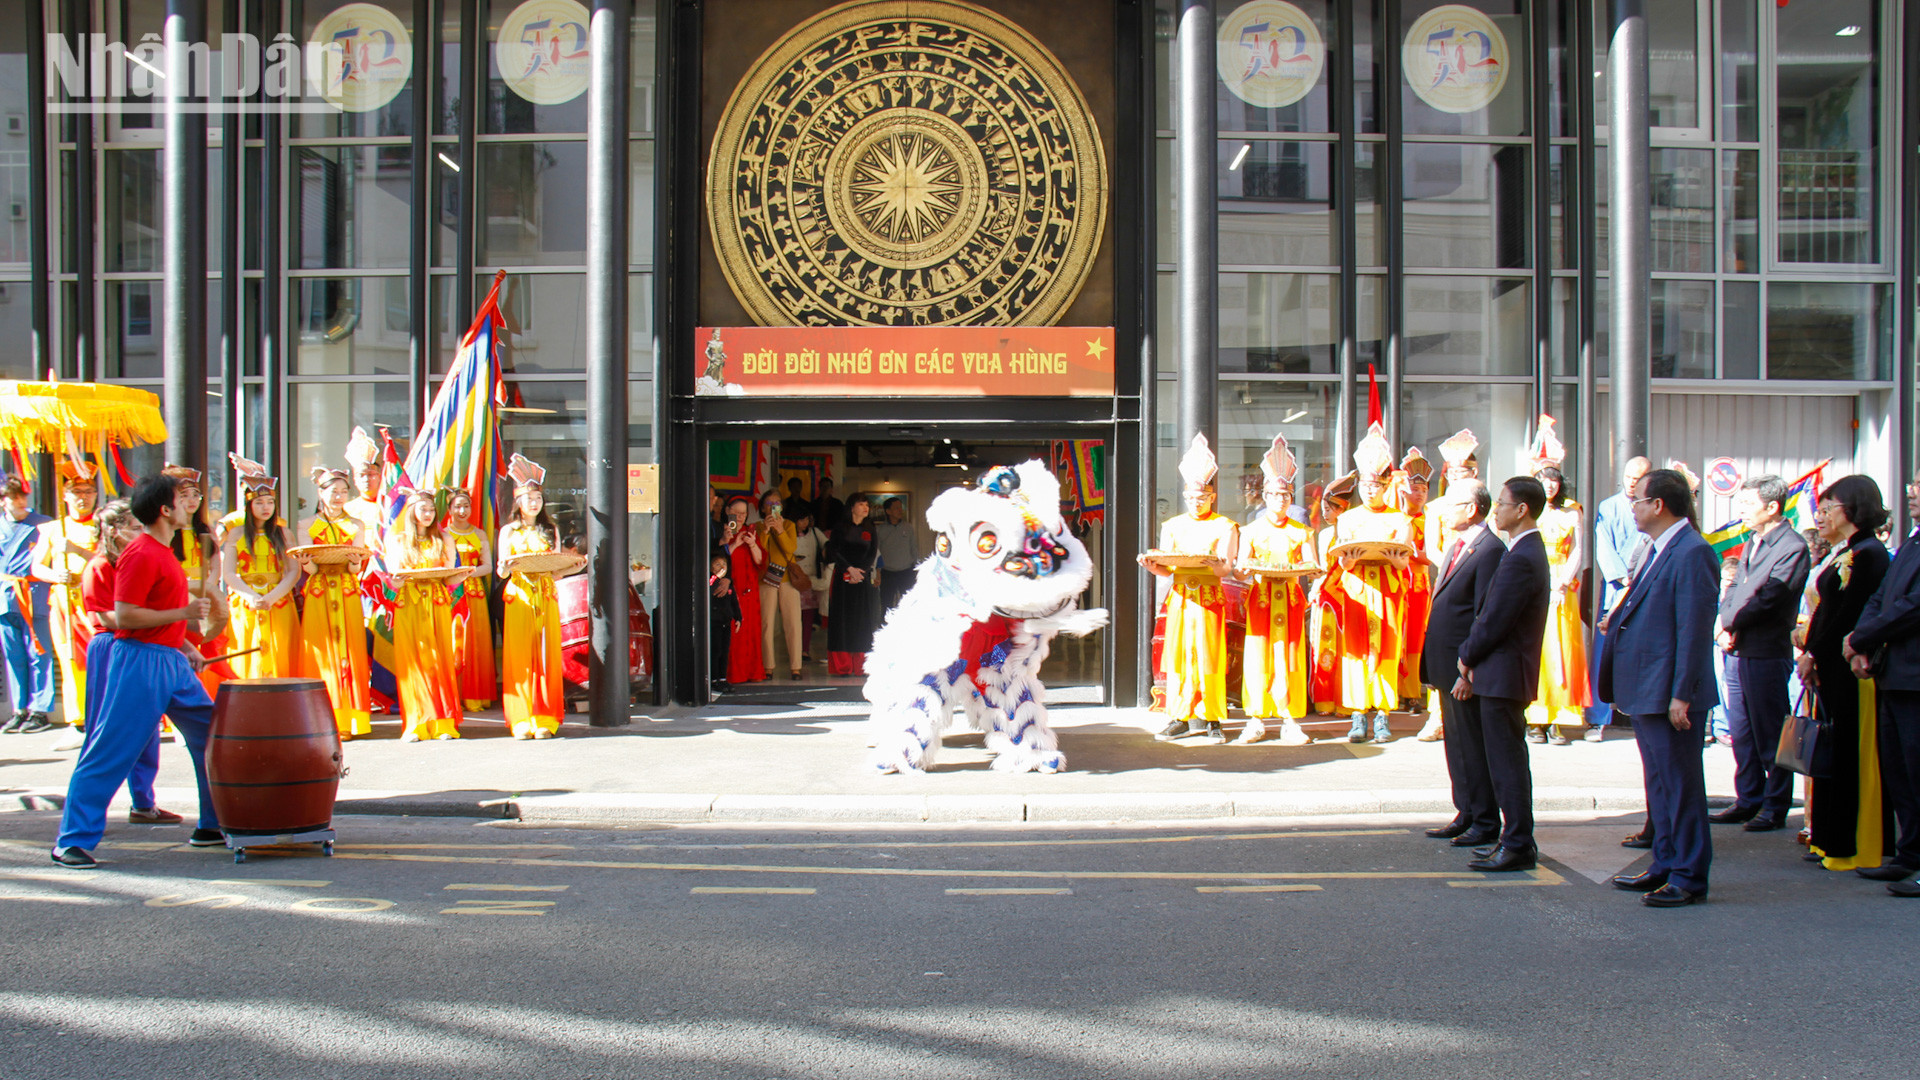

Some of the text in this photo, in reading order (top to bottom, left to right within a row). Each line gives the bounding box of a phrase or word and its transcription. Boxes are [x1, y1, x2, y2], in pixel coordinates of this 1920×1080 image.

[743, 348, 1067, 374] ĐỜI ĐỜI NHỚ ƠN CÁC VUA HÙNG
